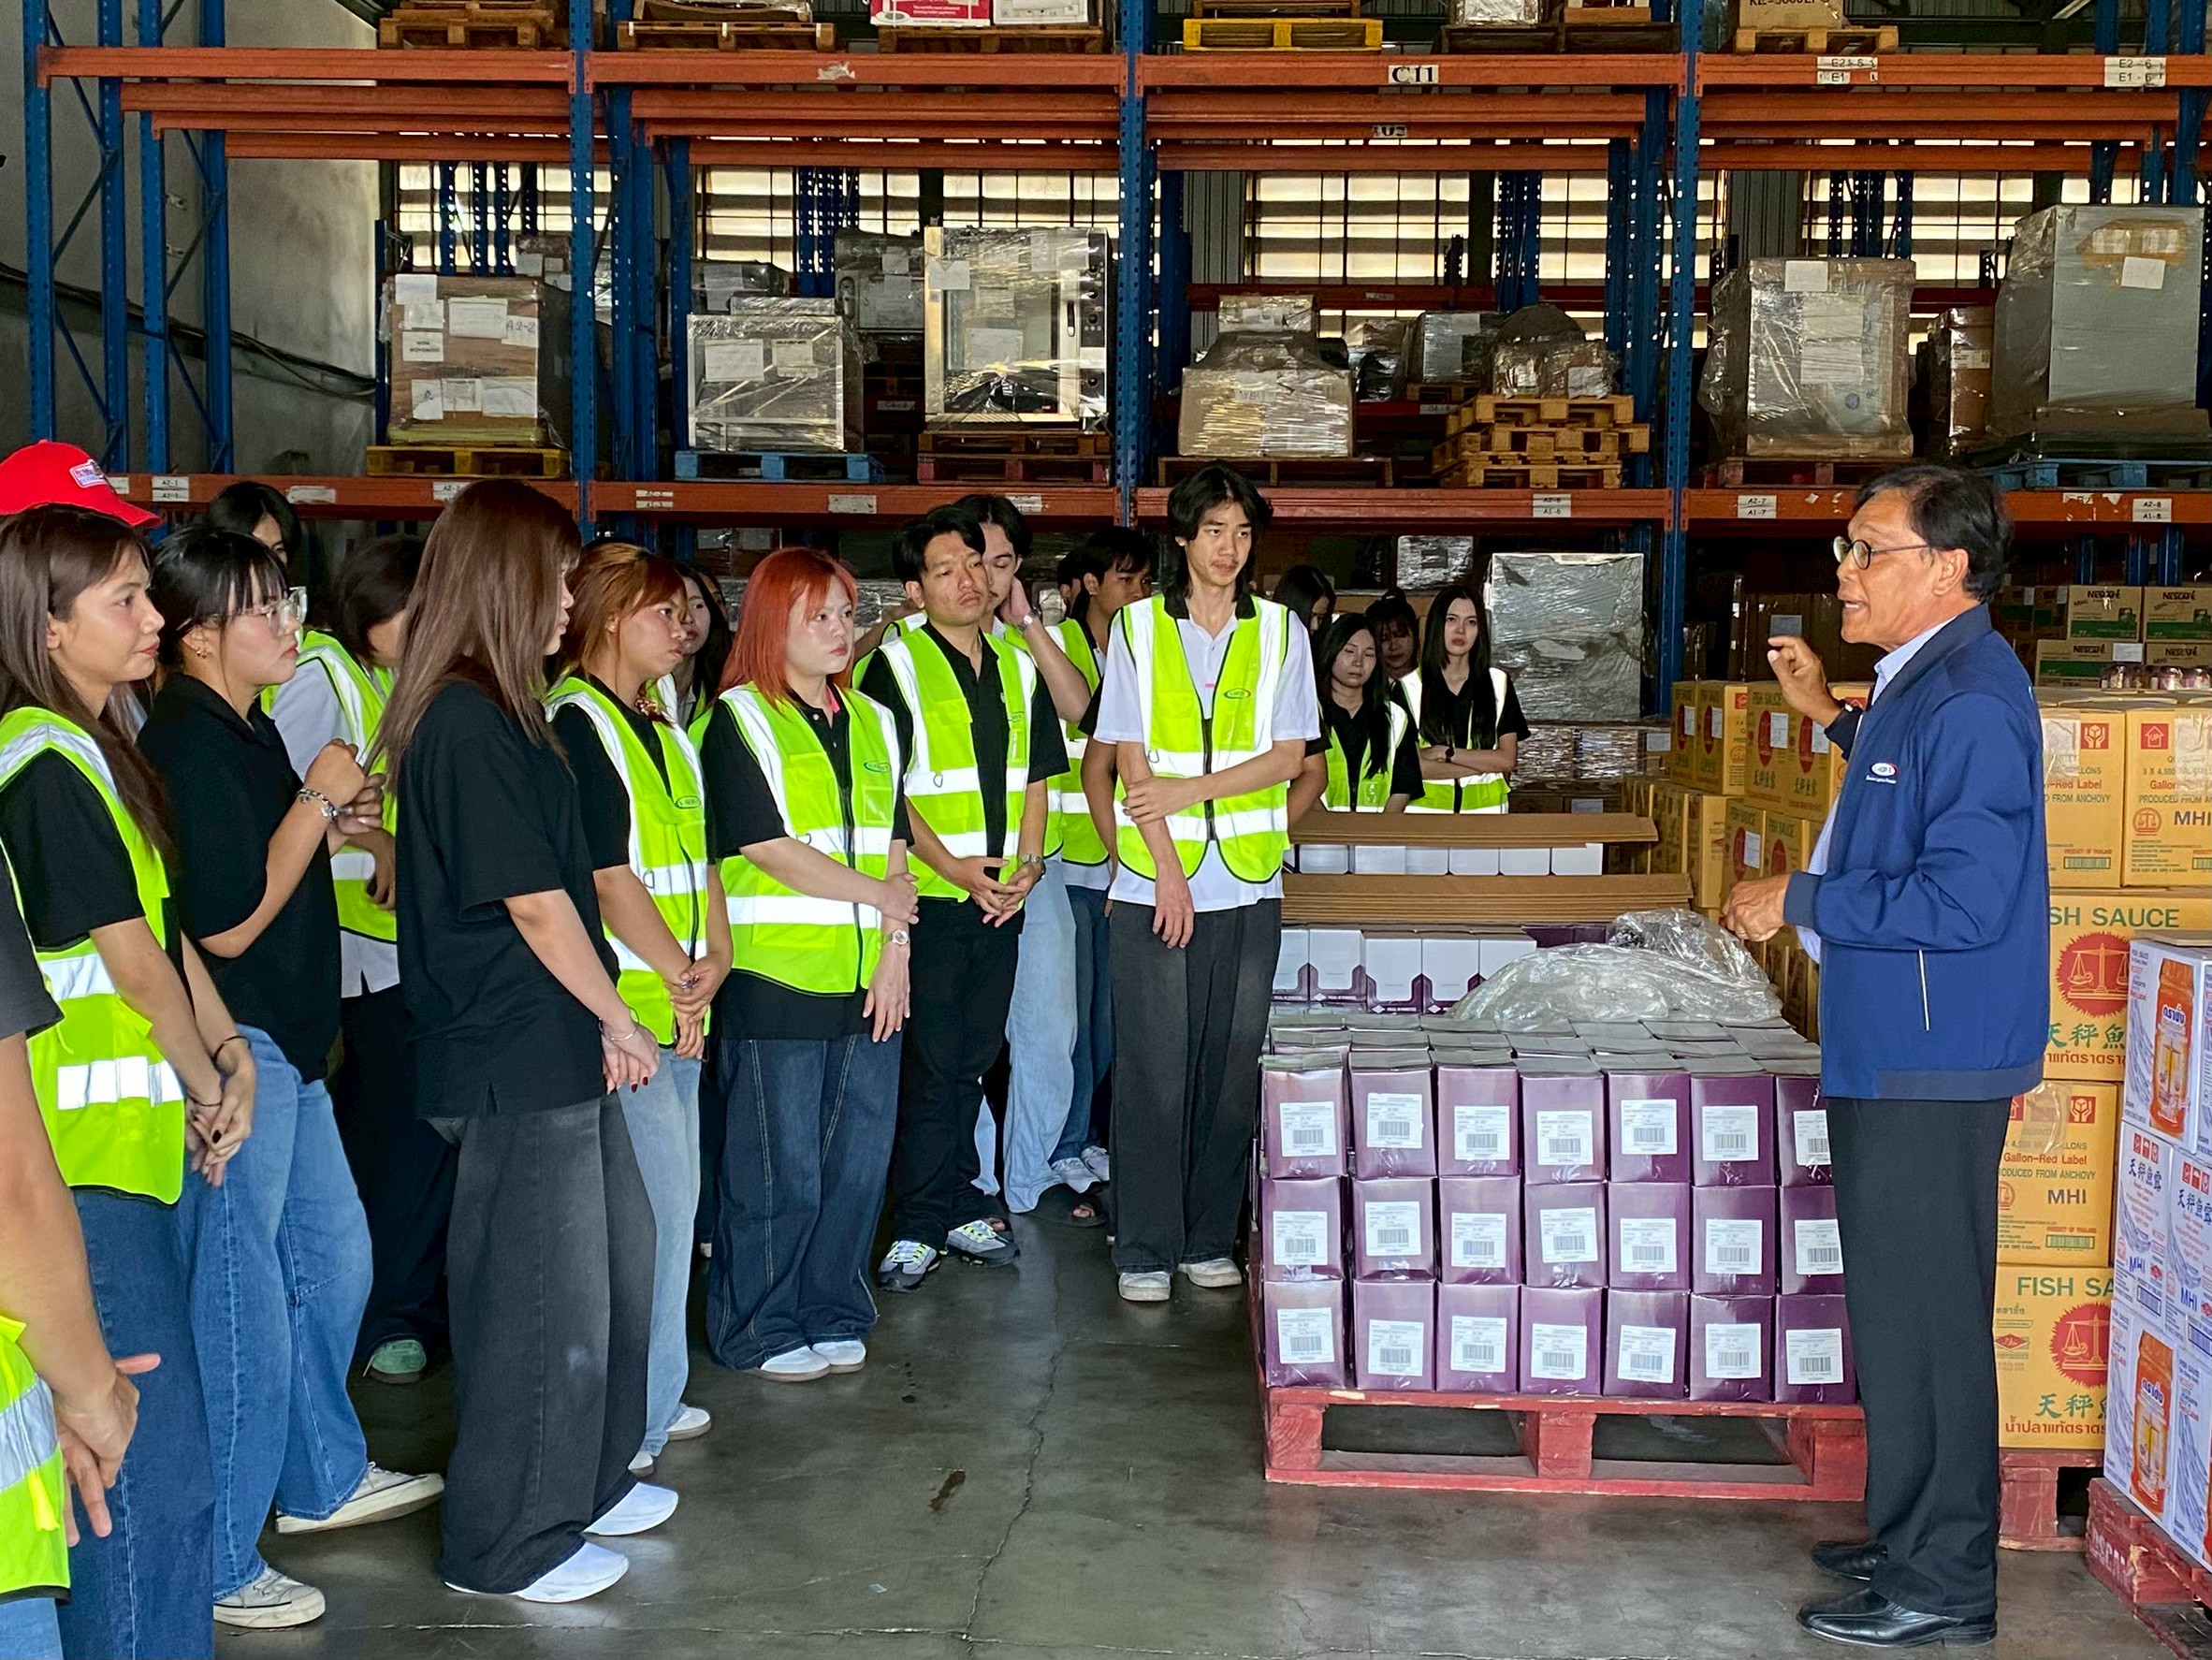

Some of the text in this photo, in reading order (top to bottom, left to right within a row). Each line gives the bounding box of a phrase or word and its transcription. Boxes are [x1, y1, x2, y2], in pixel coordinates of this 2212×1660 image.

[2077, 779, 2103, 790] Label
[2052, 794, 2111, 803] FROM ANCHOVY
[2138, 794, 2178, 804] PRODUCED
[2174, 810, 2211, 826] MHI
[2050, 906, 2180, 928] SH SAUCE
[2048, 1022, 2126, 1050] 天秤魚
[2003, 1152, 2088, 1165] Gallon-Red Label
[1999, 1168, 2096, 1180] ODUCED FROM ANCHOVY
[2047, 1188, 2087, 1204] MHI
[2016, 1276, 2074, 1297] FISH
[2035, 1392, 2108, 1420] 天秤
[2005, 1415, 2105, 1435] น้ำปลาแท้ตราตร
